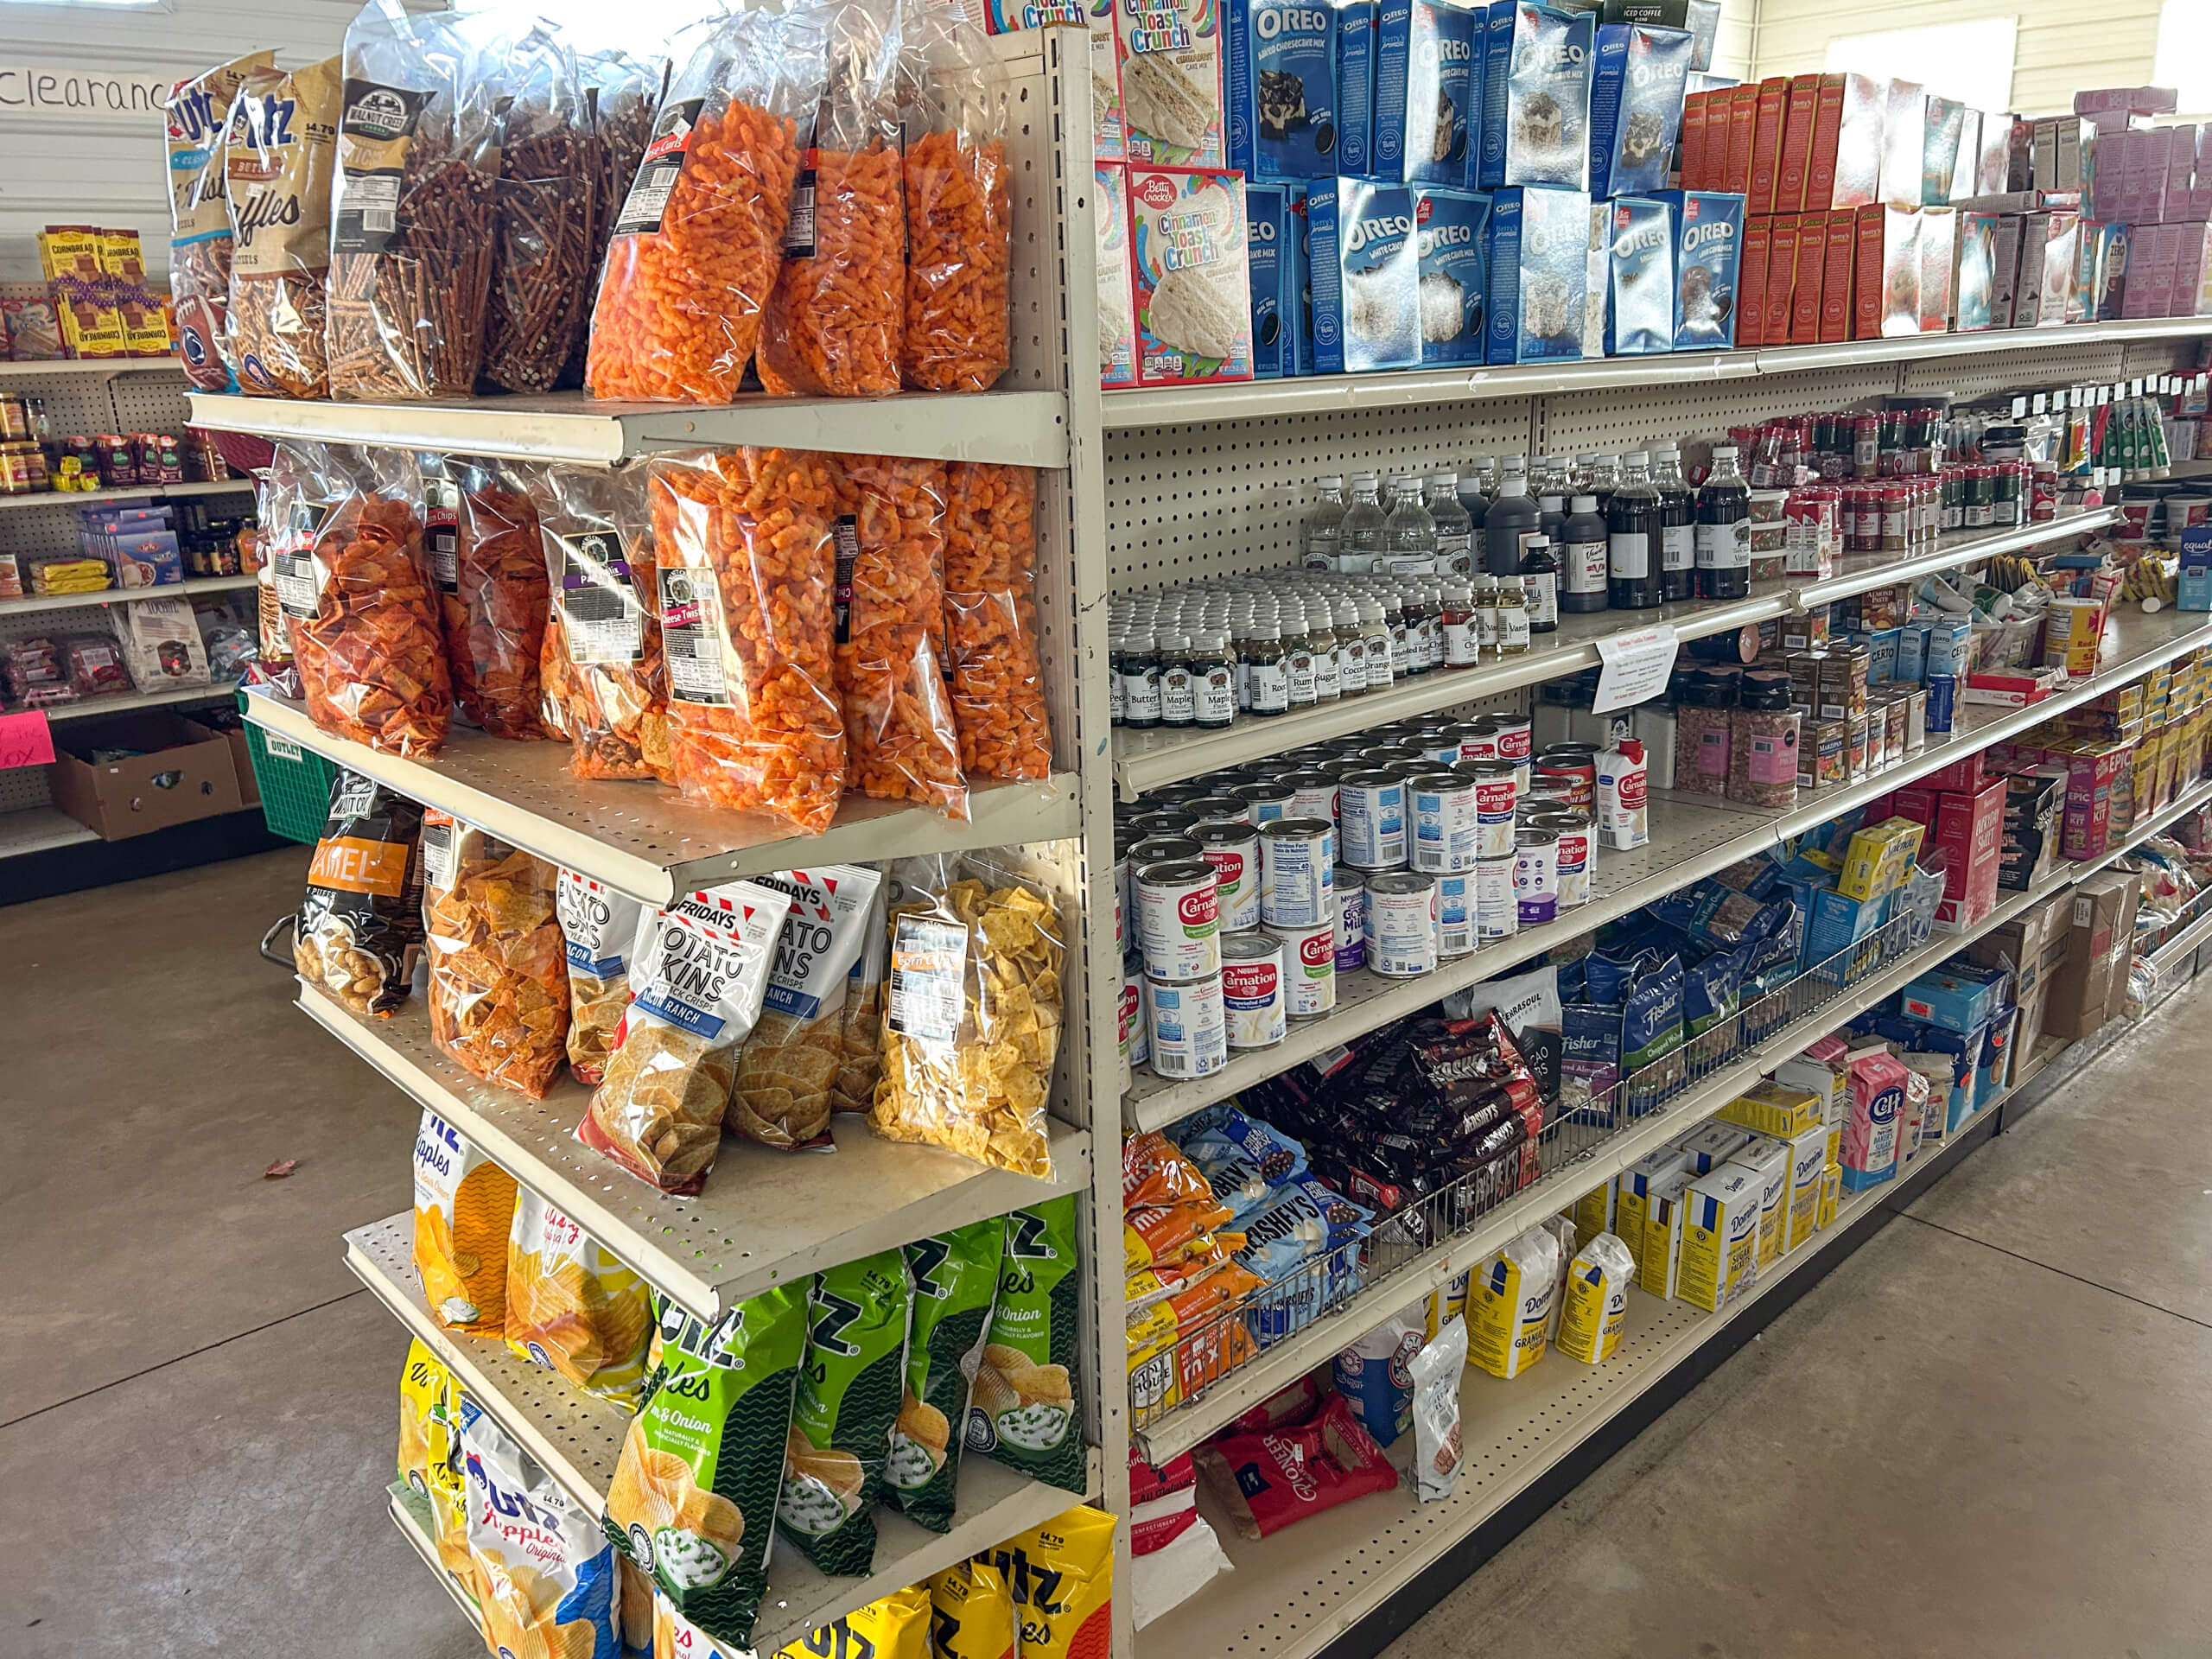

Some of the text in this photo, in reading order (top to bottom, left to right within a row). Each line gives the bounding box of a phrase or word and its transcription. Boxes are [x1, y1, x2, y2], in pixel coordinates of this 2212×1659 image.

[1140, 10, 1179, 31] Toast
[1257, 7, 1327, 40] OREO
[1382, 9, 1408, 22] OREO
[1490, 16, 1514, 29] OREO
[1344, 17, 1369, 31] OREO
[1132, 26, 1191, 54] Crunch
[1313, 39, 1325, 48] MIX
[1382, 35, 1405, 43] Betty's
[1417, 39, 1471, 67] OREO
[1601, 42, 1625, 53] OREO
[1517, 44, 1585, 74] OREO
[1633, 63, 1683, 87] OREO
[0, 70, 167, 111] Clearanc
[349, 108, 383, 125] WALNUT
[305, 124, 335, 135] $4.79
[660, 137, 683, 153] Curls
[1146, 179, 1170, 194] Betty
[1143, 190, 1175, 204] Crocker
[1308, 193, 1335, 207] OREO
[1496, 202, 1521, 214] OREO
[1158, 210, 1217, 236] Cinnamon
[1310, 219, 1335, 228] Betty's
[1172, 226, 1210, 250] Toast
[1248, 221, 1276, 243] EO
[1347, 215, 1411, 251] OREO
[1683, 222, 1735, 252] OREO
[52, 243, 94, 255] CORNBREAD
[1418, 226, 1471, 257] OREO
[1616, 230, 1668, 258] OREO
[1165, 241, 1220, 271] Crunch
[1262, 248, 1276, 258] MIX
[1369, 245, 1389, 259] WHITE
[1465, 248, 1476, 257] MIX
[2110, 245, 2126, 256] ZERO
[79, 330, 121, 341] CORNBREAD
[126, 330, 167, 341] CORNBREAD
[438, 510, 458, 522] Chips
[2183, 540, 2212, 553] equal
[1866, 588, 1894, 599] ALMOND
[1872, 647, 1895, 663] CERTO
[1364, 662, 1391, 672] Orange
[1294, 678, 1313, 687] Rum
[1315, 672, 1337, 684] Sugar
[1131, 695, 1158, 704] Butter
[1166, 695, 1192, 705] Maple
[1208, 695, 1231, 705] Maple
[271, 740, 302, 757] OUTLET
[1819, 740, 1844, 752] MARZIPAN
[2109, 749, 2133, 774] EPIC
[1476, 789, 1516, 805] Carnatio
[2068, 792, 2090, 802] EPIC
[2070, 817, 2085, 825] KIT
[2093, 808, 2107, 823] KIT
[1558, 844, 1587, 855] nation
[1215, 861, 1242, 874] ation
[312, 888, 339, 900] PUFFS
[676, 899, 736, 930] FRIDAYS
[779, 920, 833, 954] ATO
[566, 943, 589, 960] ACON
[657, 952, 726, 1002] KINS
[776, 974, 804, 989] CRISPS
[1223, 969, 1277, 989] Carnation
[684, 993, 715, 1013] CRISPS
[766, 988, 793, 1006] ANCH
[664, 995, 701, 1025] RANCH
[1503, 993, 1542, 1022] ERRASOUL
[1643, 991, 1677, 1036] Fisher
[1561, 1035, 1601, 1055] Fisher
[1873, 1091, 1902, 1117] C&H
[416, 1131, 449, 1177] ipples
[1796, 1147, 1823, 1179] Domino
[1122, 1159, 1161, 1197] mix
[1731, 1199, 1759, 1234] Domino
[1240, 1194, 1320, 1262] HERSHEY'S
[1732, 1248, 1751, 1265] SUGAR
[864, 1268, 892, 1289] $4.79
[995, 1305, 1042, 1323] & Onion
[661, 1407, 713, 1434] & Onion
[664, 1427, 694, 1442] NATURALLY
[1039, 1531, 1065, 1546] $4.79
[947, 1577, 969, 1598] $4.79
